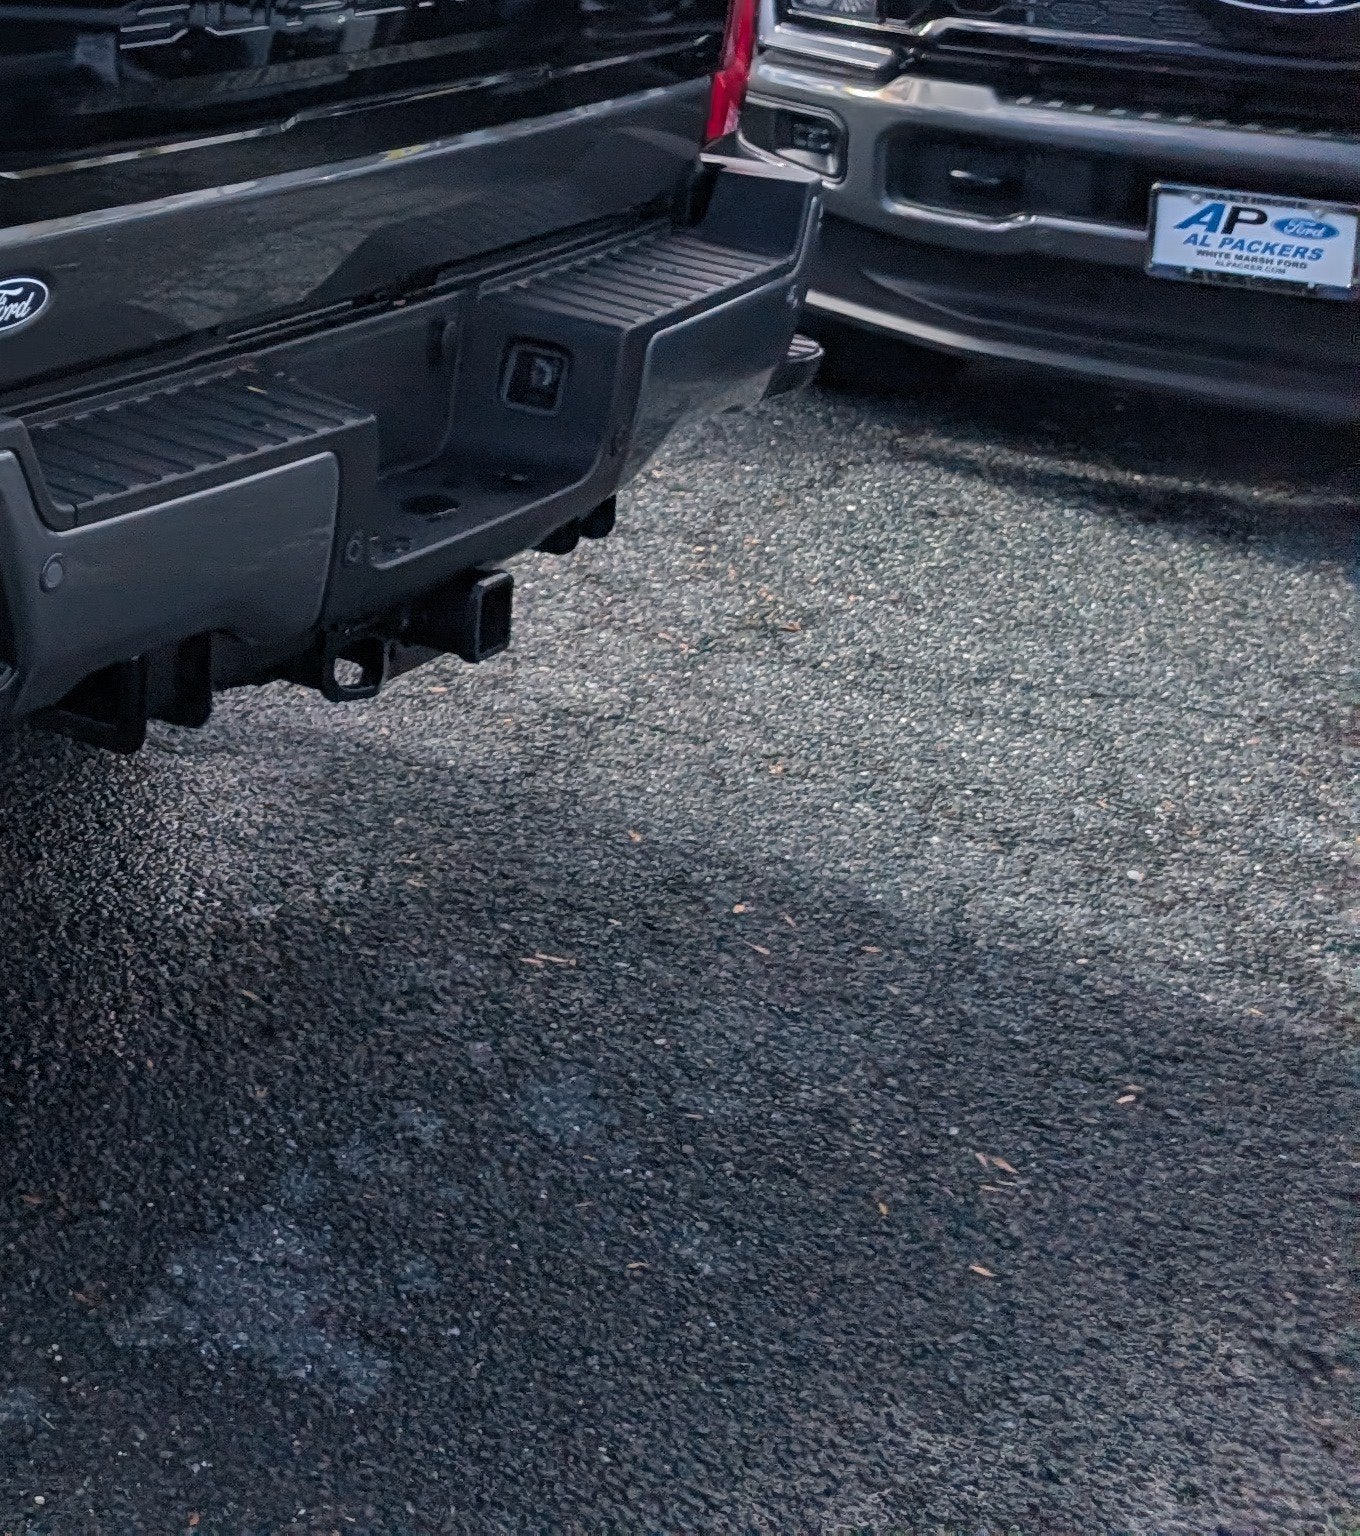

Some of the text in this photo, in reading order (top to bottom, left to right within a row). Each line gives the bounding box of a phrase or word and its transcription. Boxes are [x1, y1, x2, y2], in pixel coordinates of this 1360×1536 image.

[1173, 203, 1328, 240] AP Ford
[1182, 233, 1324, 261] AL PACKERS
[1196, 249, 1308, 270] WHITE MARSH FORD
